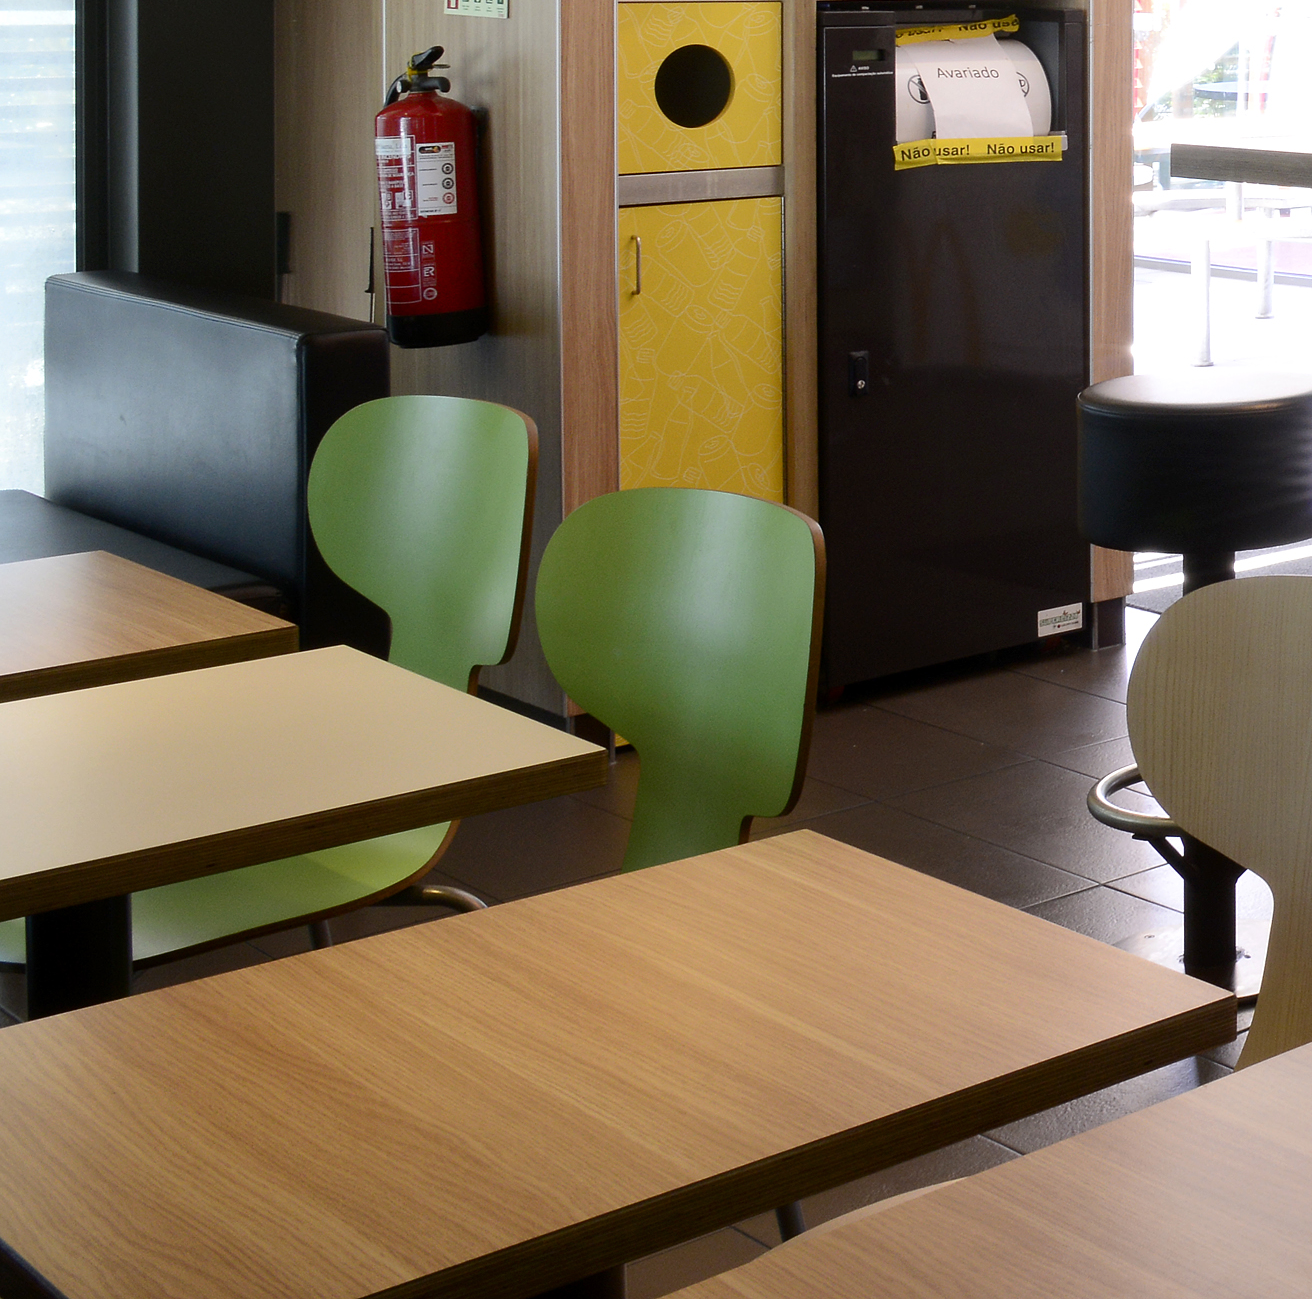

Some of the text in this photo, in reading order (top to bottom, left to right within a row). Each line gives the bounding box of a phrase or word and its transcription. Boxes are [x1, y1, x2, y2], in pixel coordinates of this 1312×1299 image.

[937, 67, 1000, 79] Avariado
[901, 142, 1054, 161] Não usar! Não usar!
